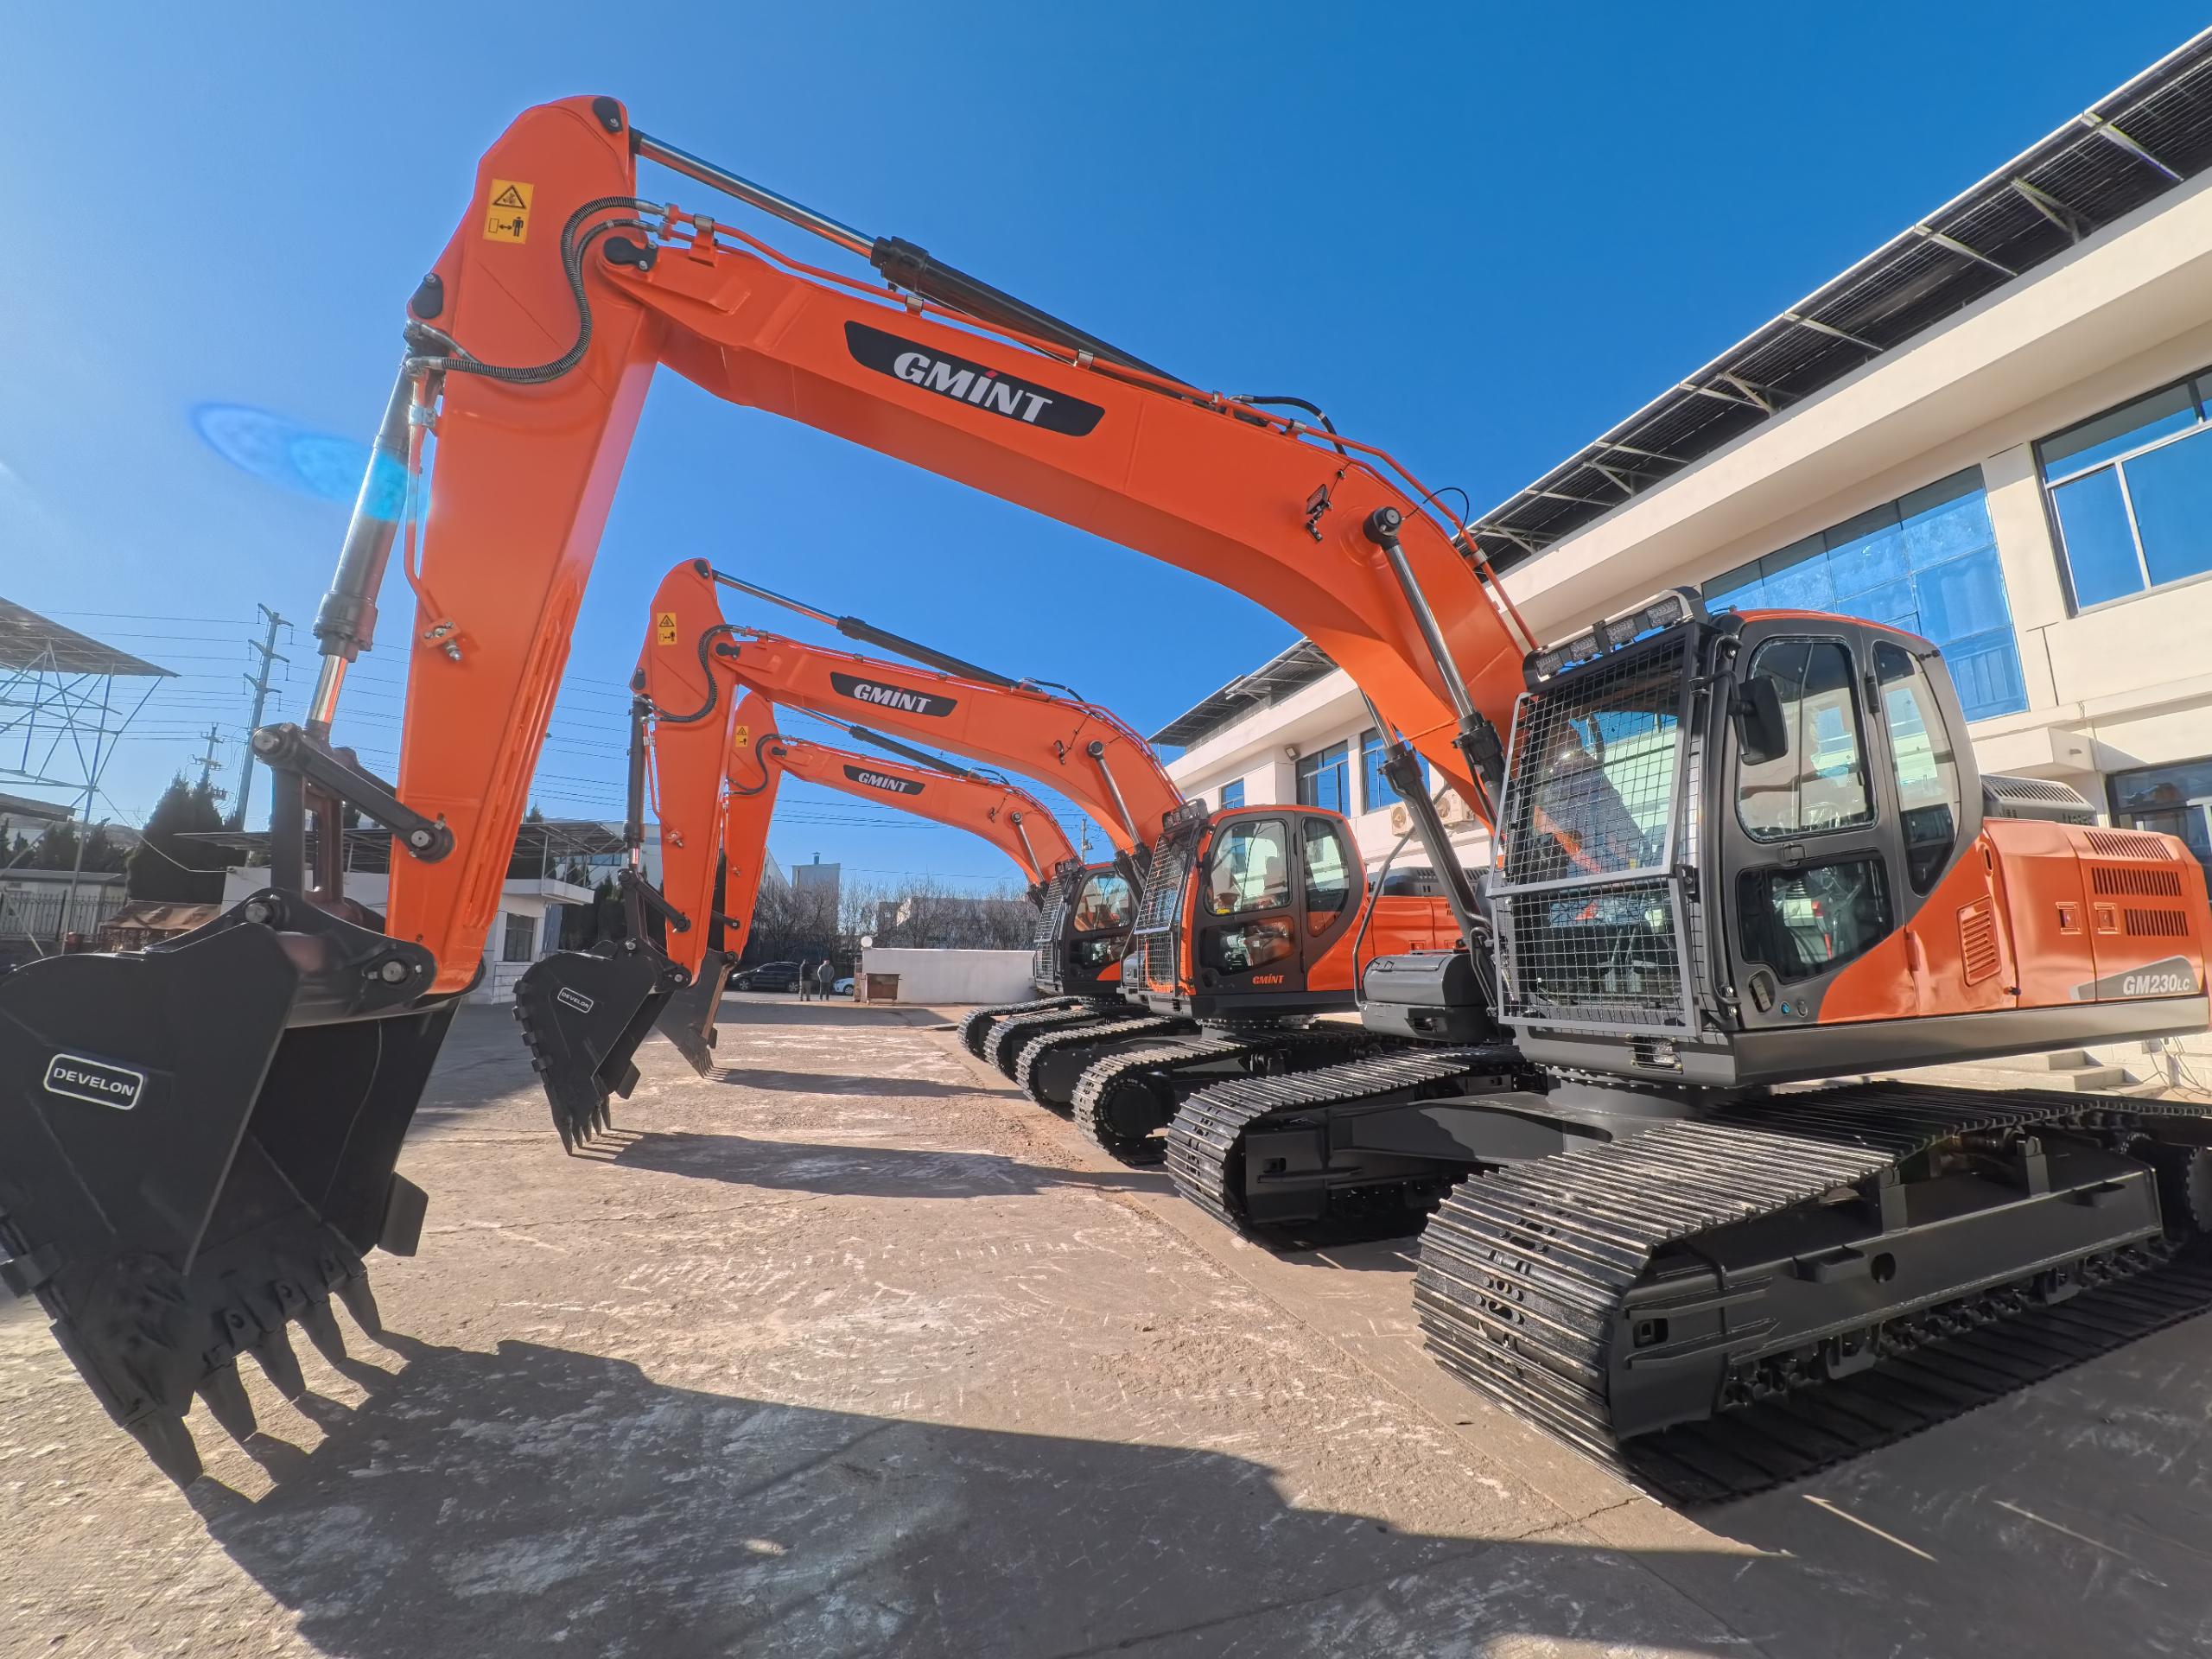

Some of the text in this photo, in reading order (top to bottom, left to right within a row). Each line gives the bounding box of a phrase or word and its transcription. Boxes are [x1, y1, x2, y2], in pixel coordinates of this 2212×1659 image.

[893, 352, 1053, 423] GMINT
[854, 683, 931, 713] GMINT
[858, 772, 909, 792] GMINT
[561, 991, 590, 1009] DEVELON
[53, 1067, 135, 1096] DEVELON
